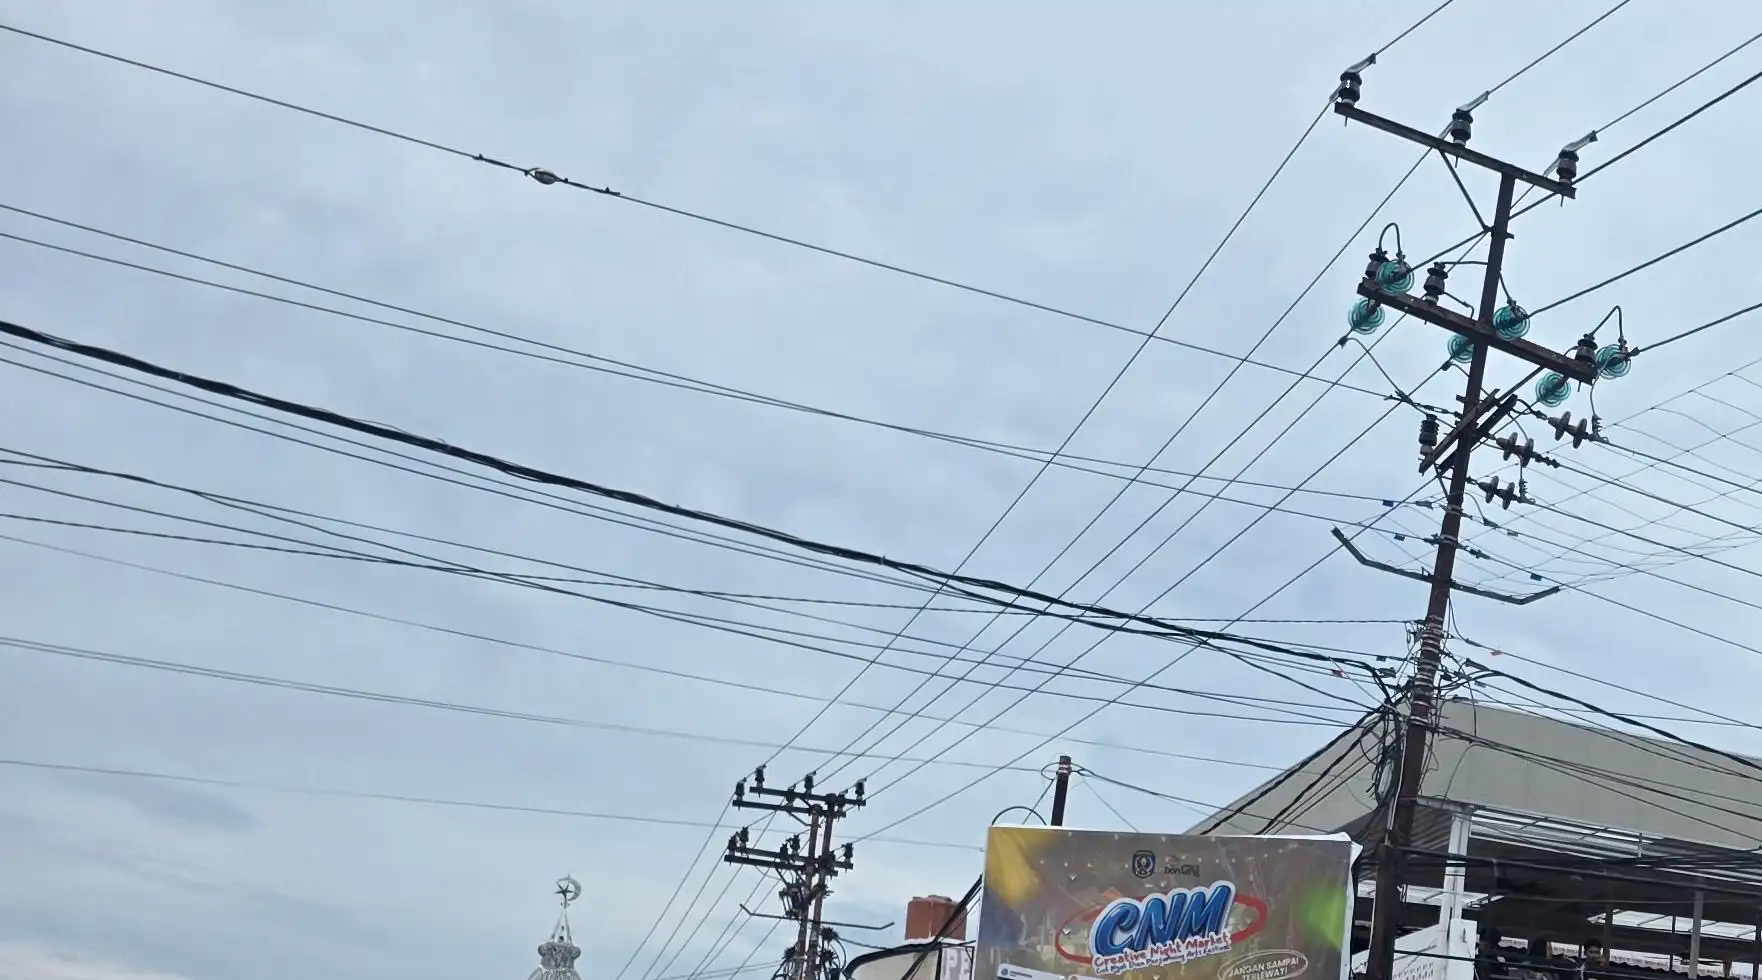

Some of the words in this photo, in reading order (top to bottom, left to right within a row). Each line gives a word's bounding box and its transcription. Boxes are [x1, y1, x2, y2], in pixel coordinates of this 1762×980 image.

[1094, 884, 1232, 957] CNM
[1094, 949, 1146, 967] Creative
[1150, 941, 1181, 959] Night
[1186, 934, 1229, 950] Market
[1229, 963, 1265, 977] JANGAN
[1266, 957, 1299, 970] SAMPAI
